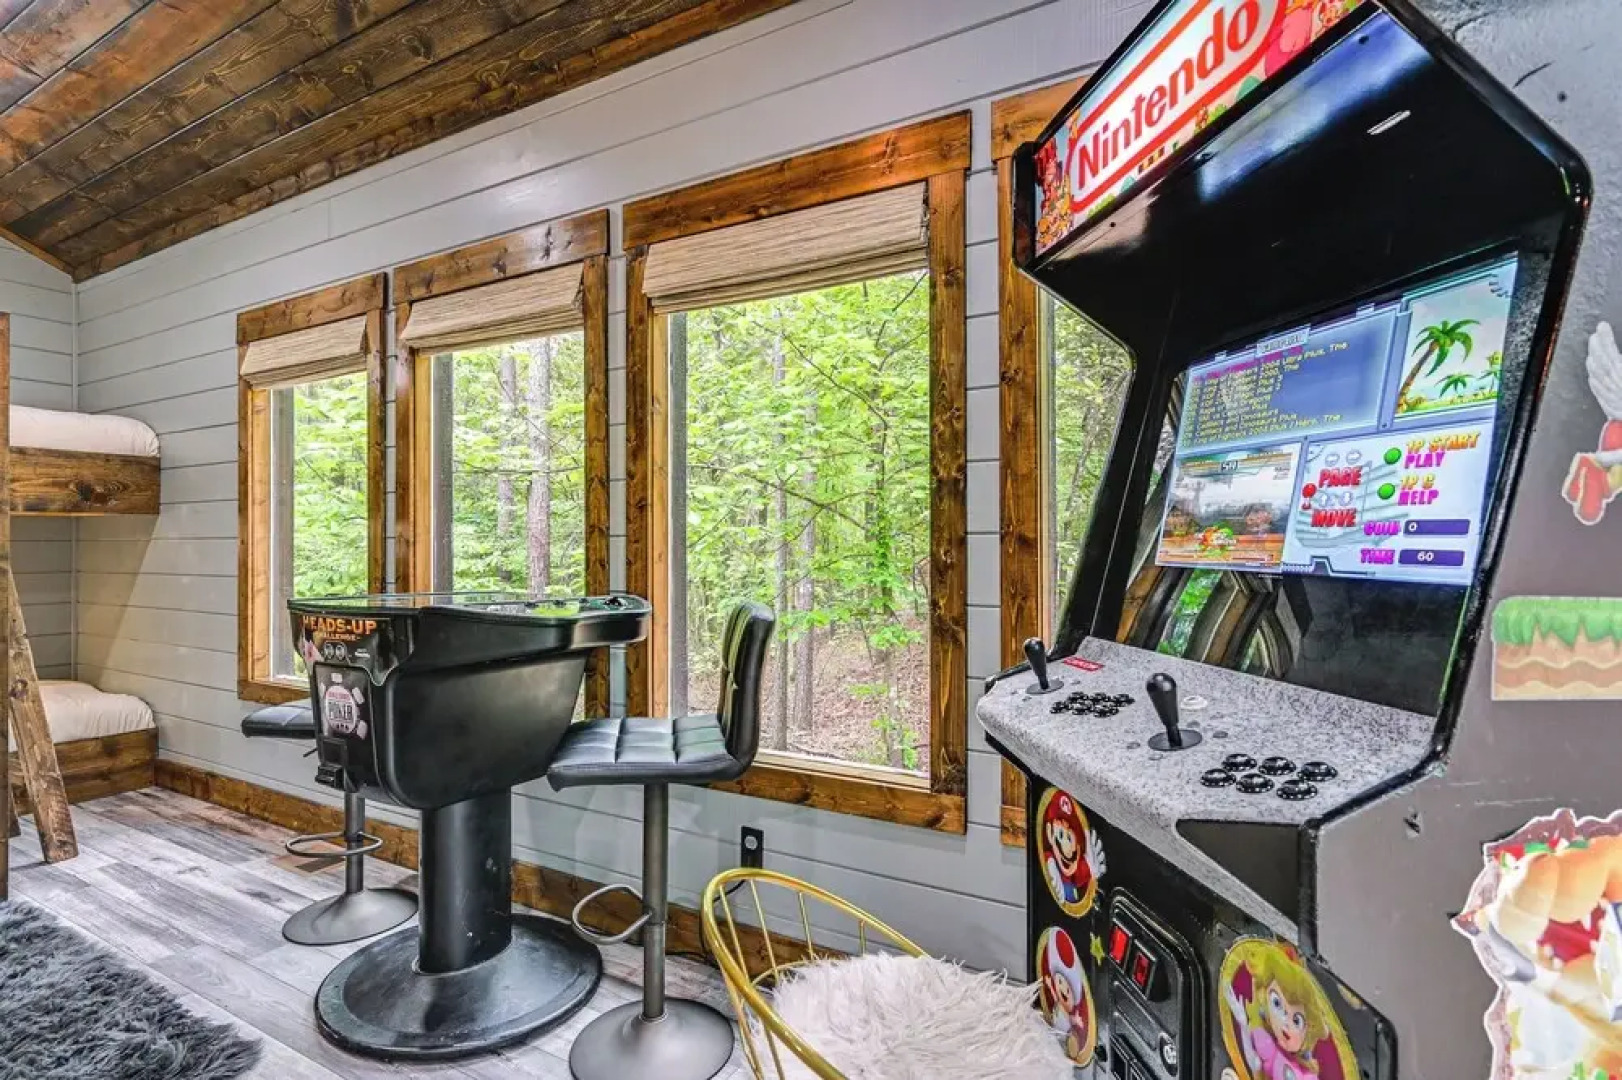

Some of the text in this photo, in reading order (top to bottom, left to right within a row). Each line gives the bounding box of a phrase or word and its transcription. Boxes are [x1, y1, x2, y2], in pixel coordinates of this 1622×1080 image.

[1076, 0, 1261, 191] Nintendo
[1429, 432, 1480, 452] START
[1404, 451, 1446, 469] PLAY
[1319, 465, 1363, 489] PAGE
[1398, 489, 1440, 507] HELP
[1311, 508, 1358, 528] MOVE
[1362, 520, 1402, 536] COIN
[1360, 547, 1396, 565] TIME
[1417, 550, 1434, 561] 60
[302, 615, 377, 635] HEADS-UP
